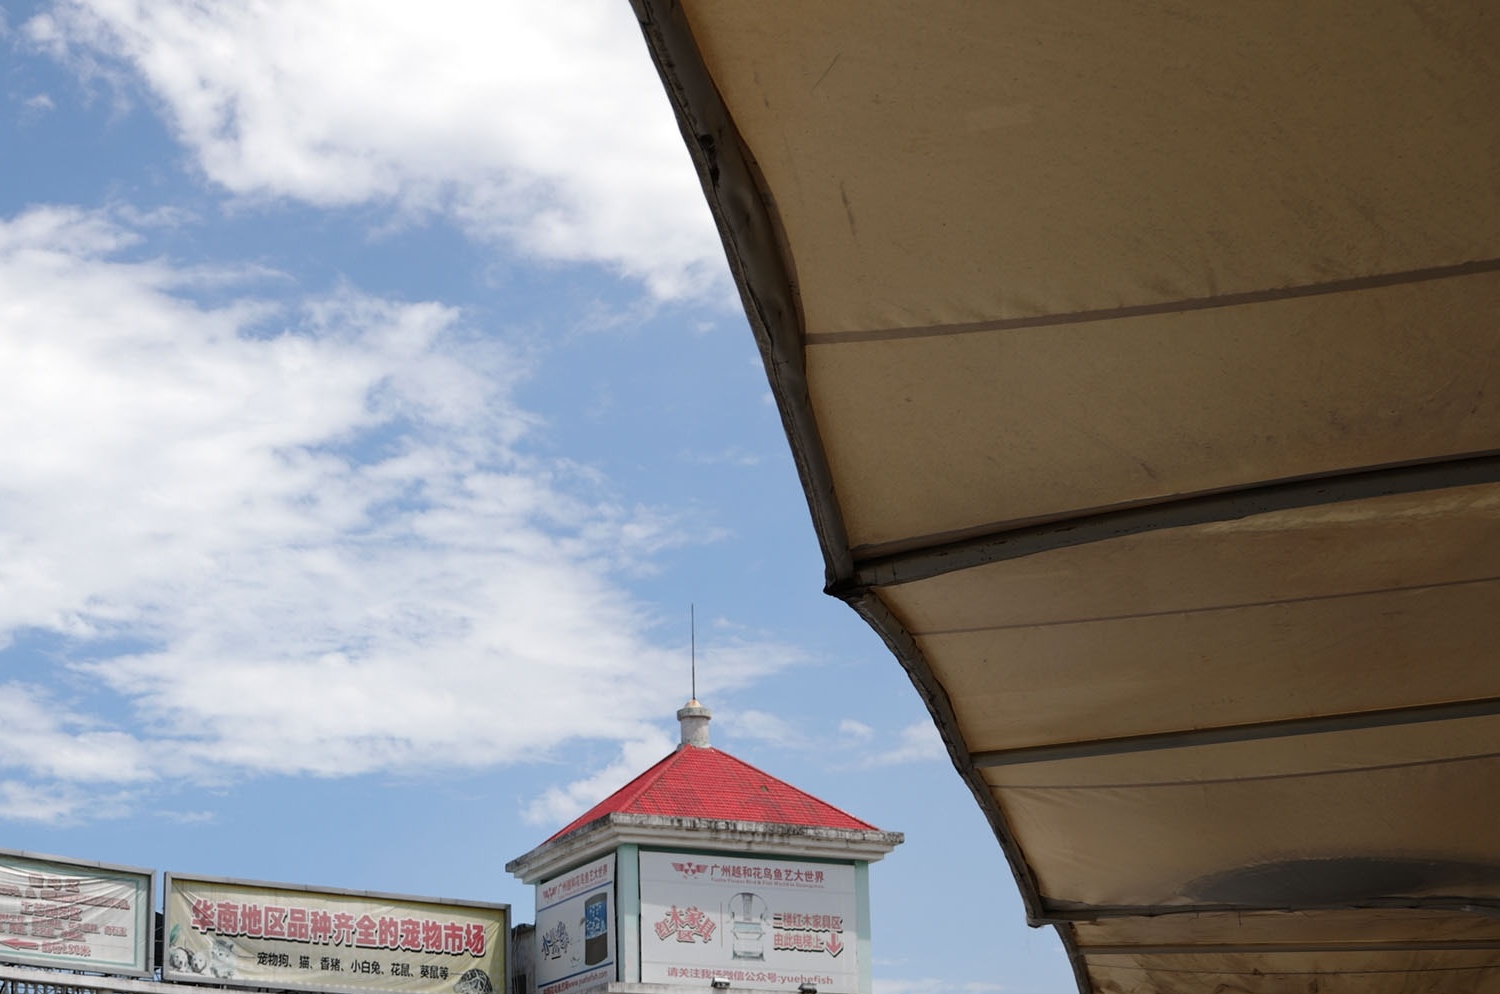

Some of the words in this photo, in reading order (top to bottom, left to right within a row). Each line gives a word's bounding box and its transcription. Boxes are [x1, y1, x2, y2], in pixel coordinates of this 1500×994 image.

[710, 864, 824, 883] 广州越和花鸟鱼艺大世界
[191, 899, 487, 956] 华南地区品种齐全的宠物市场
[773, 932, 823, 951] 由此电梯上
